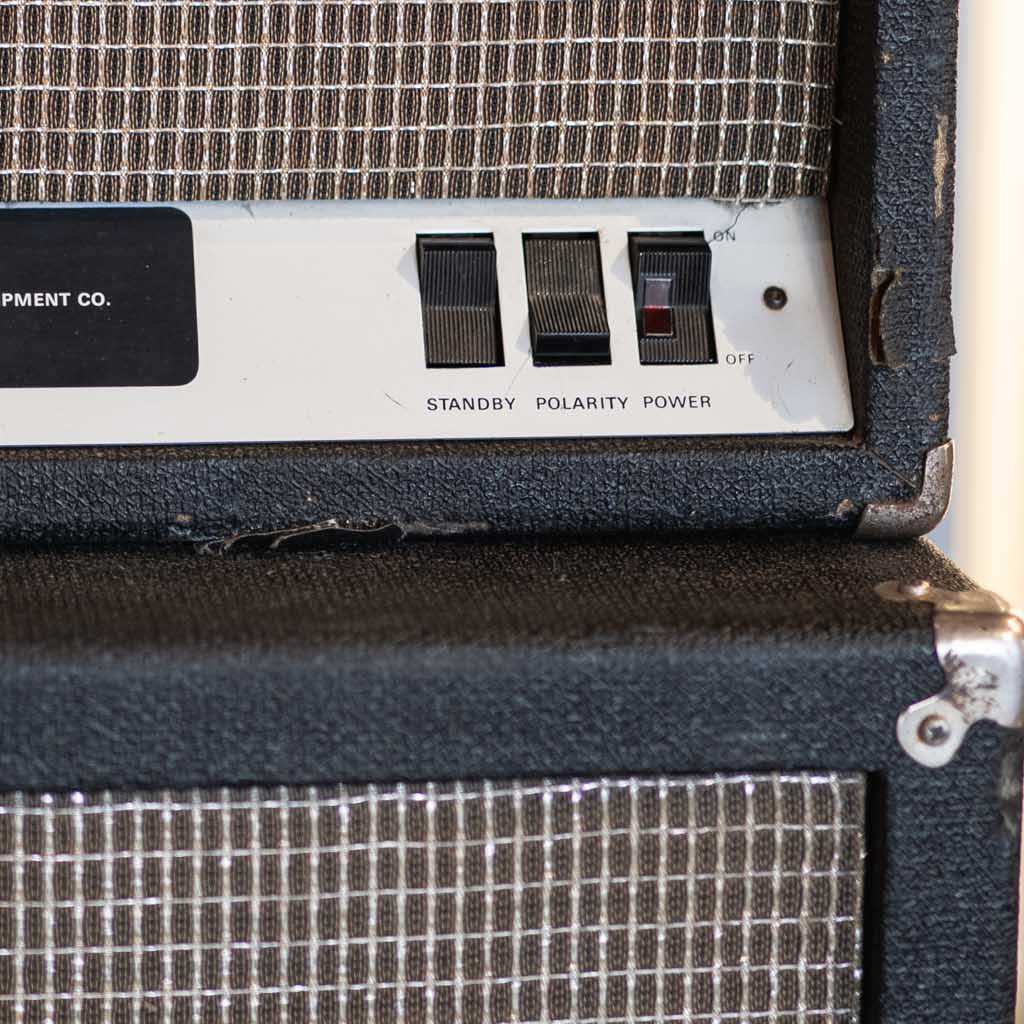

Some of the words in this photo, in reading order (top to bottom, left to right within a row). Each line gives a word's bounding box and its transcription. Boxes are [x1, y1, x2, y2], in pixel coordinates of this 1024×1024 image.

[713, 230, 737, 243] ON
[77, 291, 112, 307] CO.
[725, 352, 756, 366] OFF
[426, 396, 517, 412] STANDBY
[536, 396, 630, 411] POLARITY
[642, 394, 713, 410] POWER
